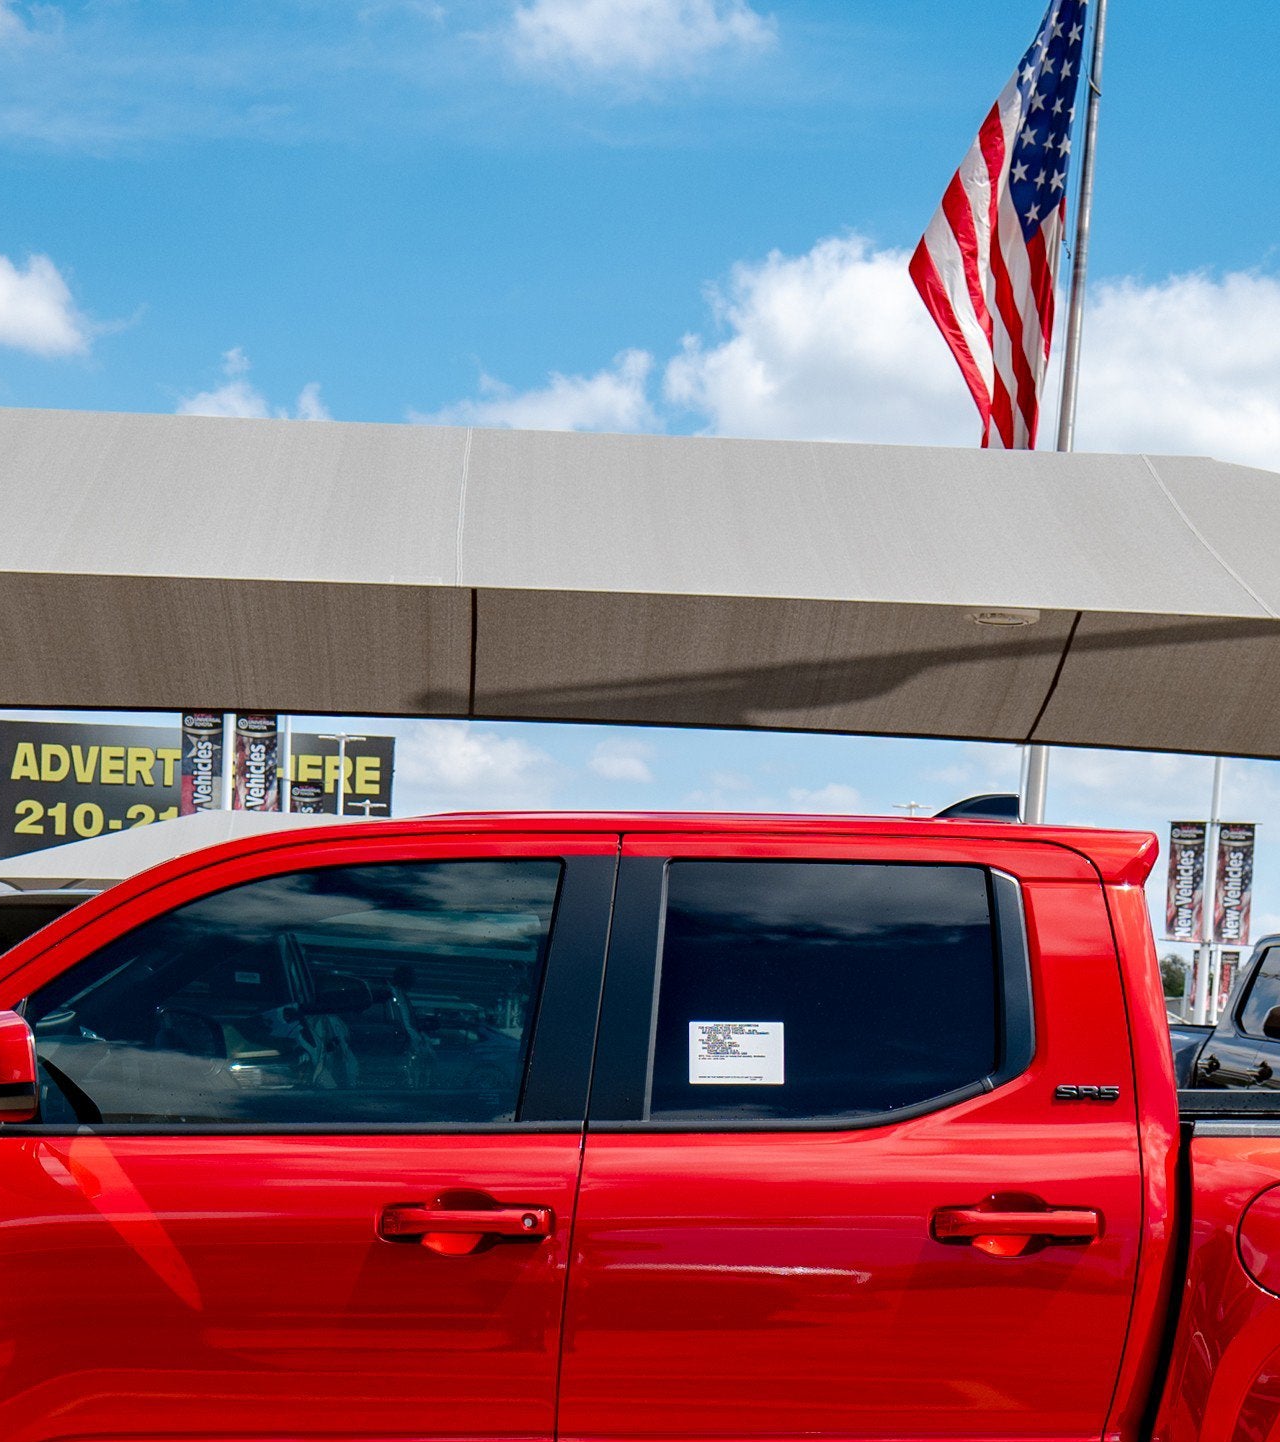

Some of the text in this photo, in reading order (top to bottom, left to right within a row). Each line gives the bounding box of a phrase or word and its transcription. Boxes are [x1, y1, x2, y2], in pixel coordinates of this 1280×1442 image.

[10, 742, 182, 786] ADVERT
[193, 740, 213, 804] Vehicles
[246, 743, 266, 807] Vehicles
[1175, 849, 1195, 906] Vehicles
[1223, 851, 1244, 908] Vehicles
[1175, 907, 1193, 938] New
[1222, 909, 1241, 939] New
[1054, 1085, 1120, 1101] SR5
